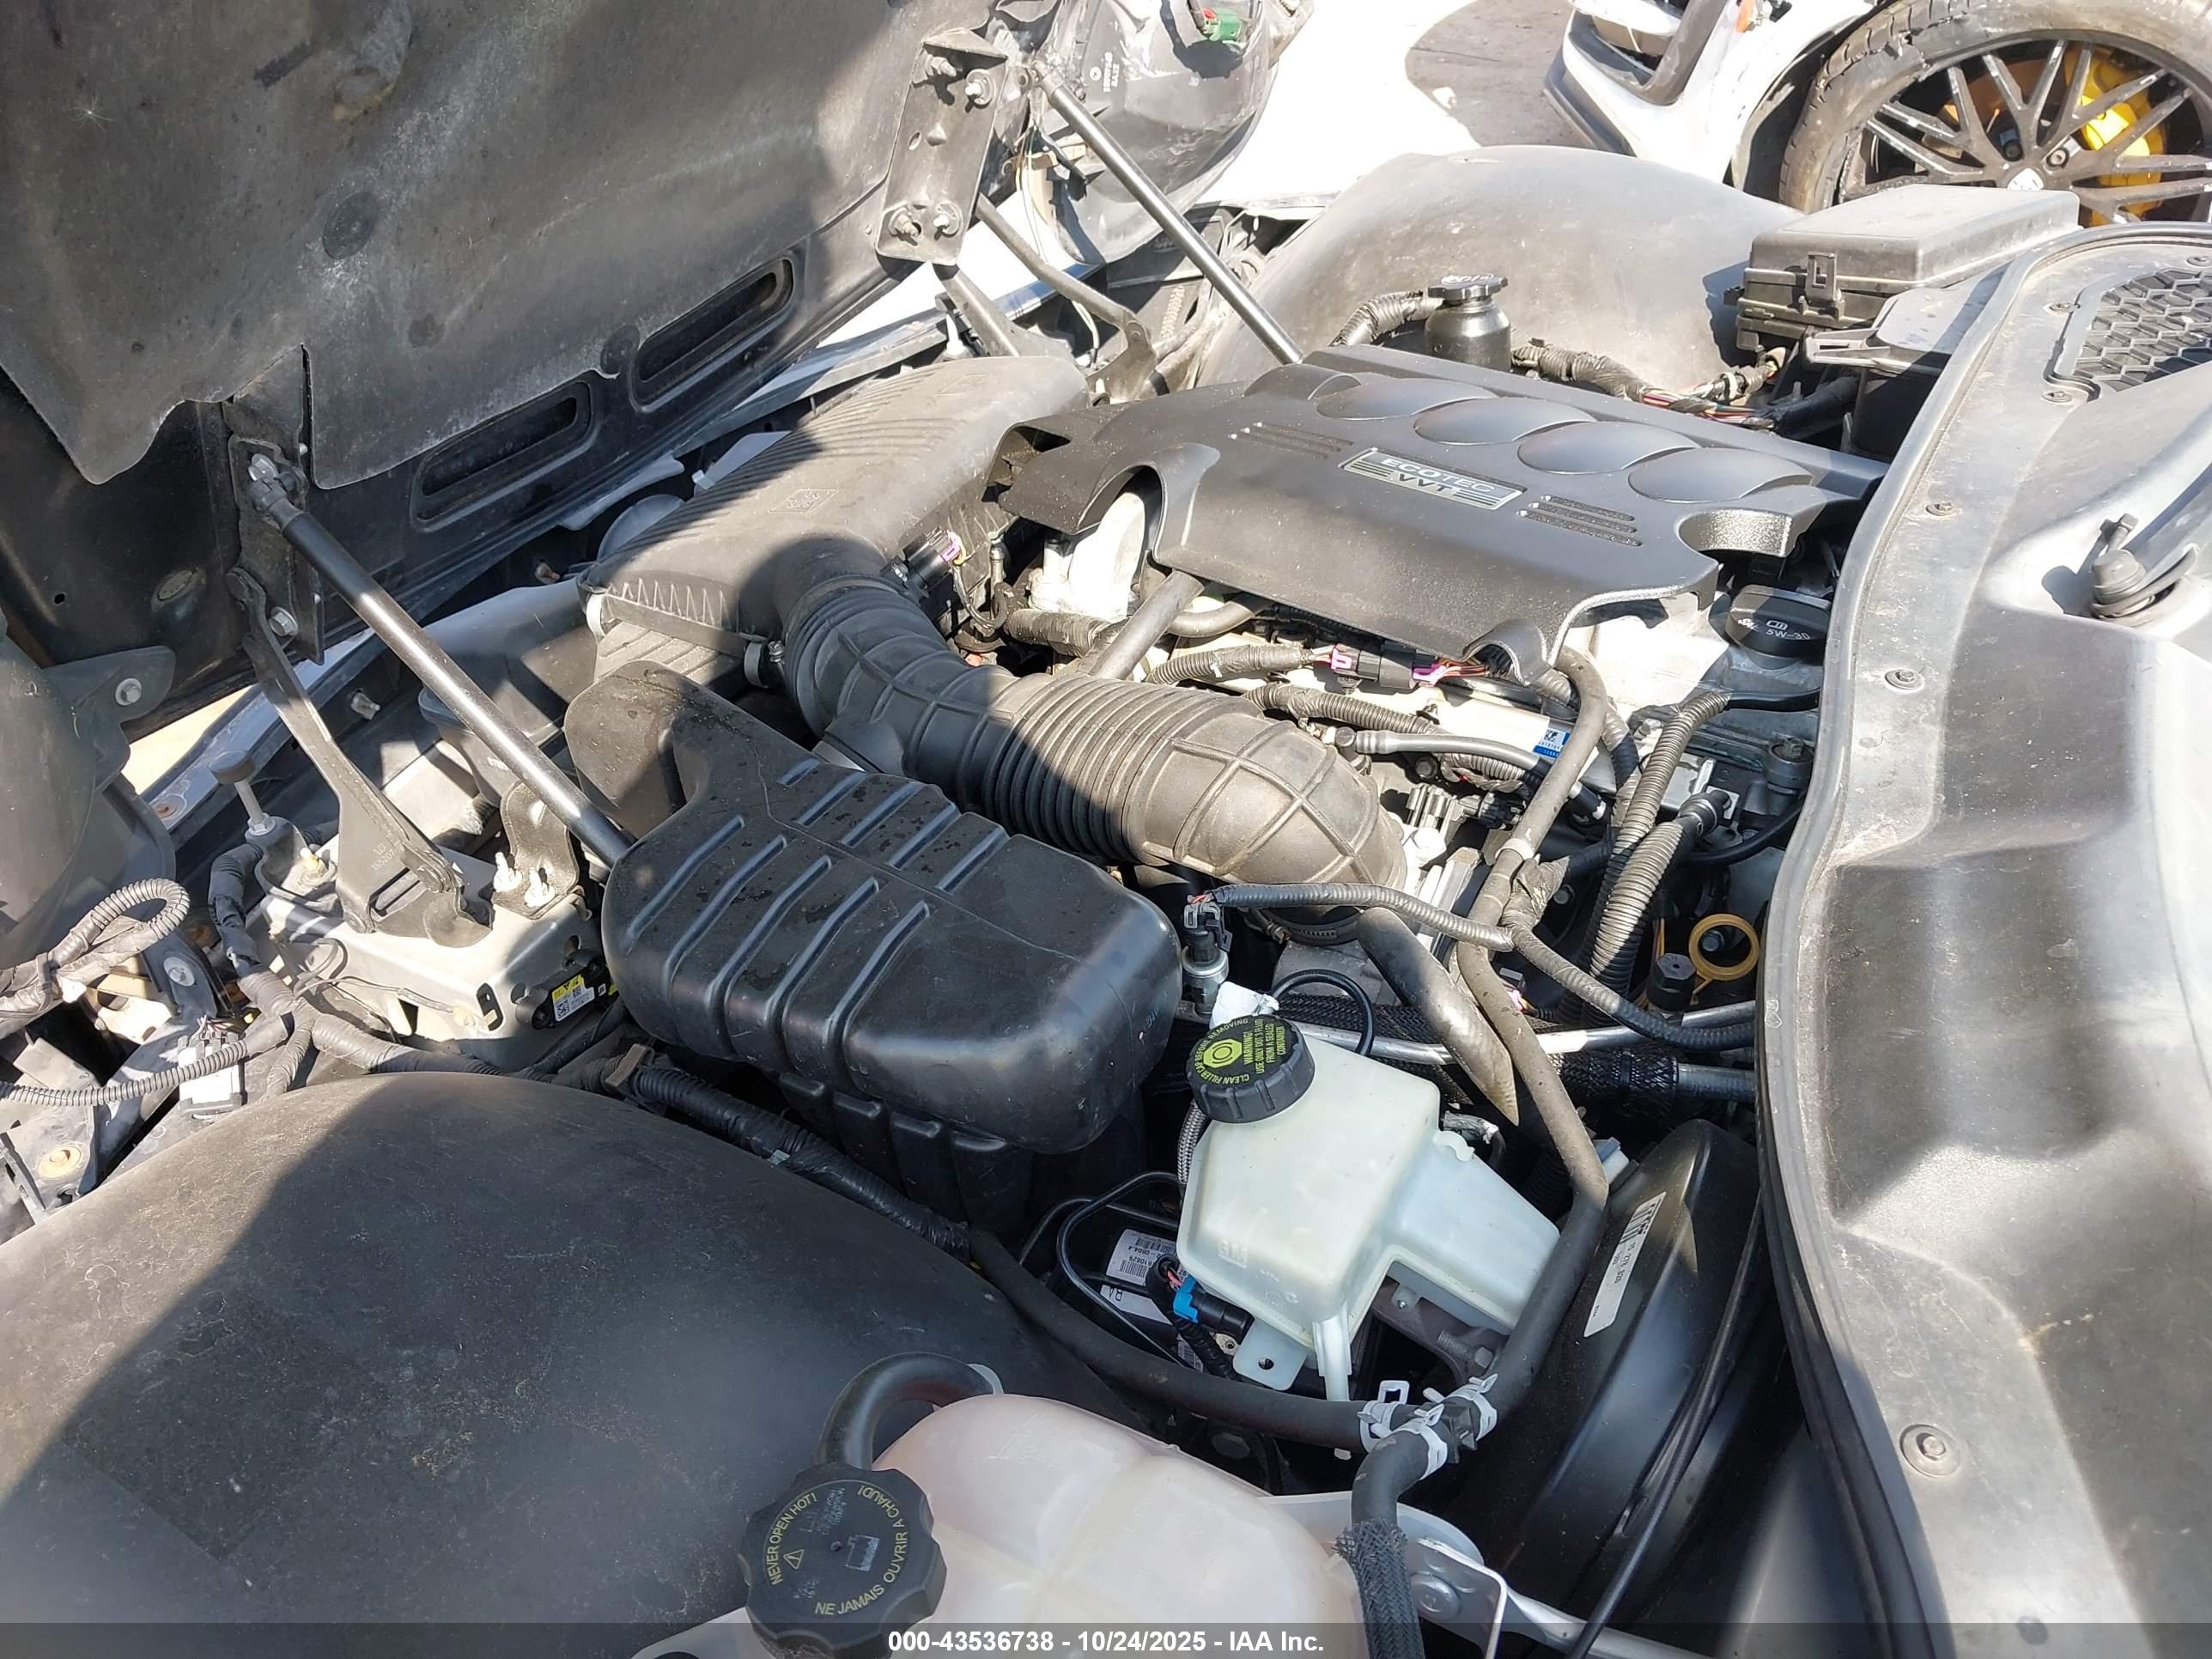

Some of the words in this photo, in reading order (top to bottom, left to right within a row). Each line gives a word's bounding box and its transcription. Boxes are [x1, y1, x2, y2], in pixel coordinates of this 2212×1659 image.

[1380, 458, 1495, 493] ECOTEC
[1397, 473, 1455, 492] VVT
[1765, 629, 1811, 641] 5W-30
[1207, 1018, 1249, 1040] REMOVING
[1255, 1018, 1263, 1032] FLUID
[1265, 1023, 1274, 1041] SEALED
[1243, 1030, 1254, 1065] WARNING!
[1255, 1037, 1263, 1048] DOT
[1275, 1026, 1286, 1055] CONTAINER
[1194, 1039, 1211, 1061] BEFORE
[1255, 1048, 1265, 1061] ONLY
[1266, 1047, 1276, 1063] FROM
[1194, 1062, 1206, 1073] CAP
[1255, 1061, 1265, 1074] USE
[1200, 1070, 1223, 1084] FILLER
[1223, 1073, 1250, 1085] CLEAN
[789, 1492, 817, 1516] HOT!
[857, 1486, 900, 1518] CHAUD!
[769, 1513, 794, 1544] OPEN
[892, 1518, 906, 1528] A
[766, 1545, 783, 1585] NEVER
[883, 1531, 908, 1583] OUVRIR
[815, 1601, 836, 1615] NE
[837, 1584, 884, 1614] JAMAIS
